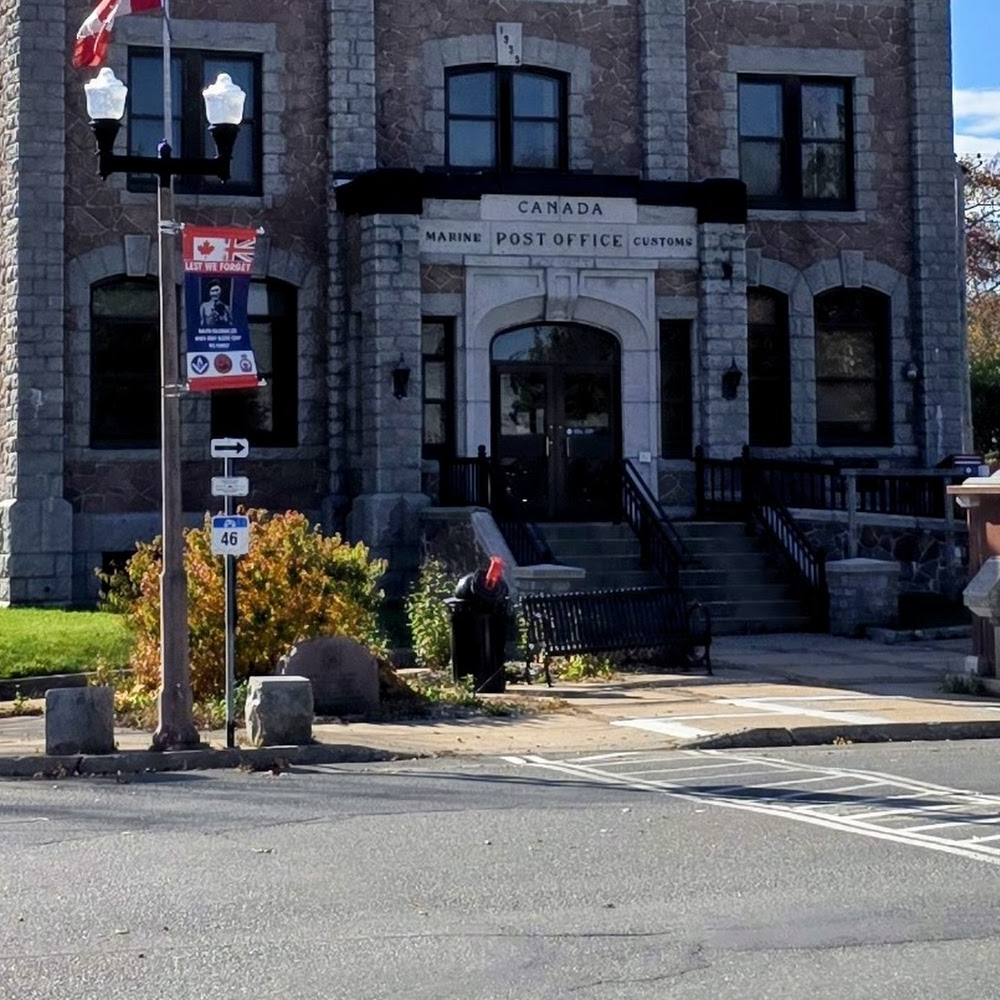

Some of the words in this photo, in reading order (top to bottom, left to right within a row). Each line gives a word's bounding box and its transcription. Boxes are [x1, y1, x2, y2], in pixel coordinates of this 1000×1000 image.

[518, 200, 603, 216] CANADA
[425, 231, 482, 243] MARINE
[496, 231, 547, 246] POST
[553, 232, 623, 248] OFFICE
[633, 236, 693, 248] CUSTOMS
[185, 261, 203, 271] LEST
[205, 262, 217, 271] WE
[219, 262, 251, 272] FORGET
[220, 531, 238, 546] 46
